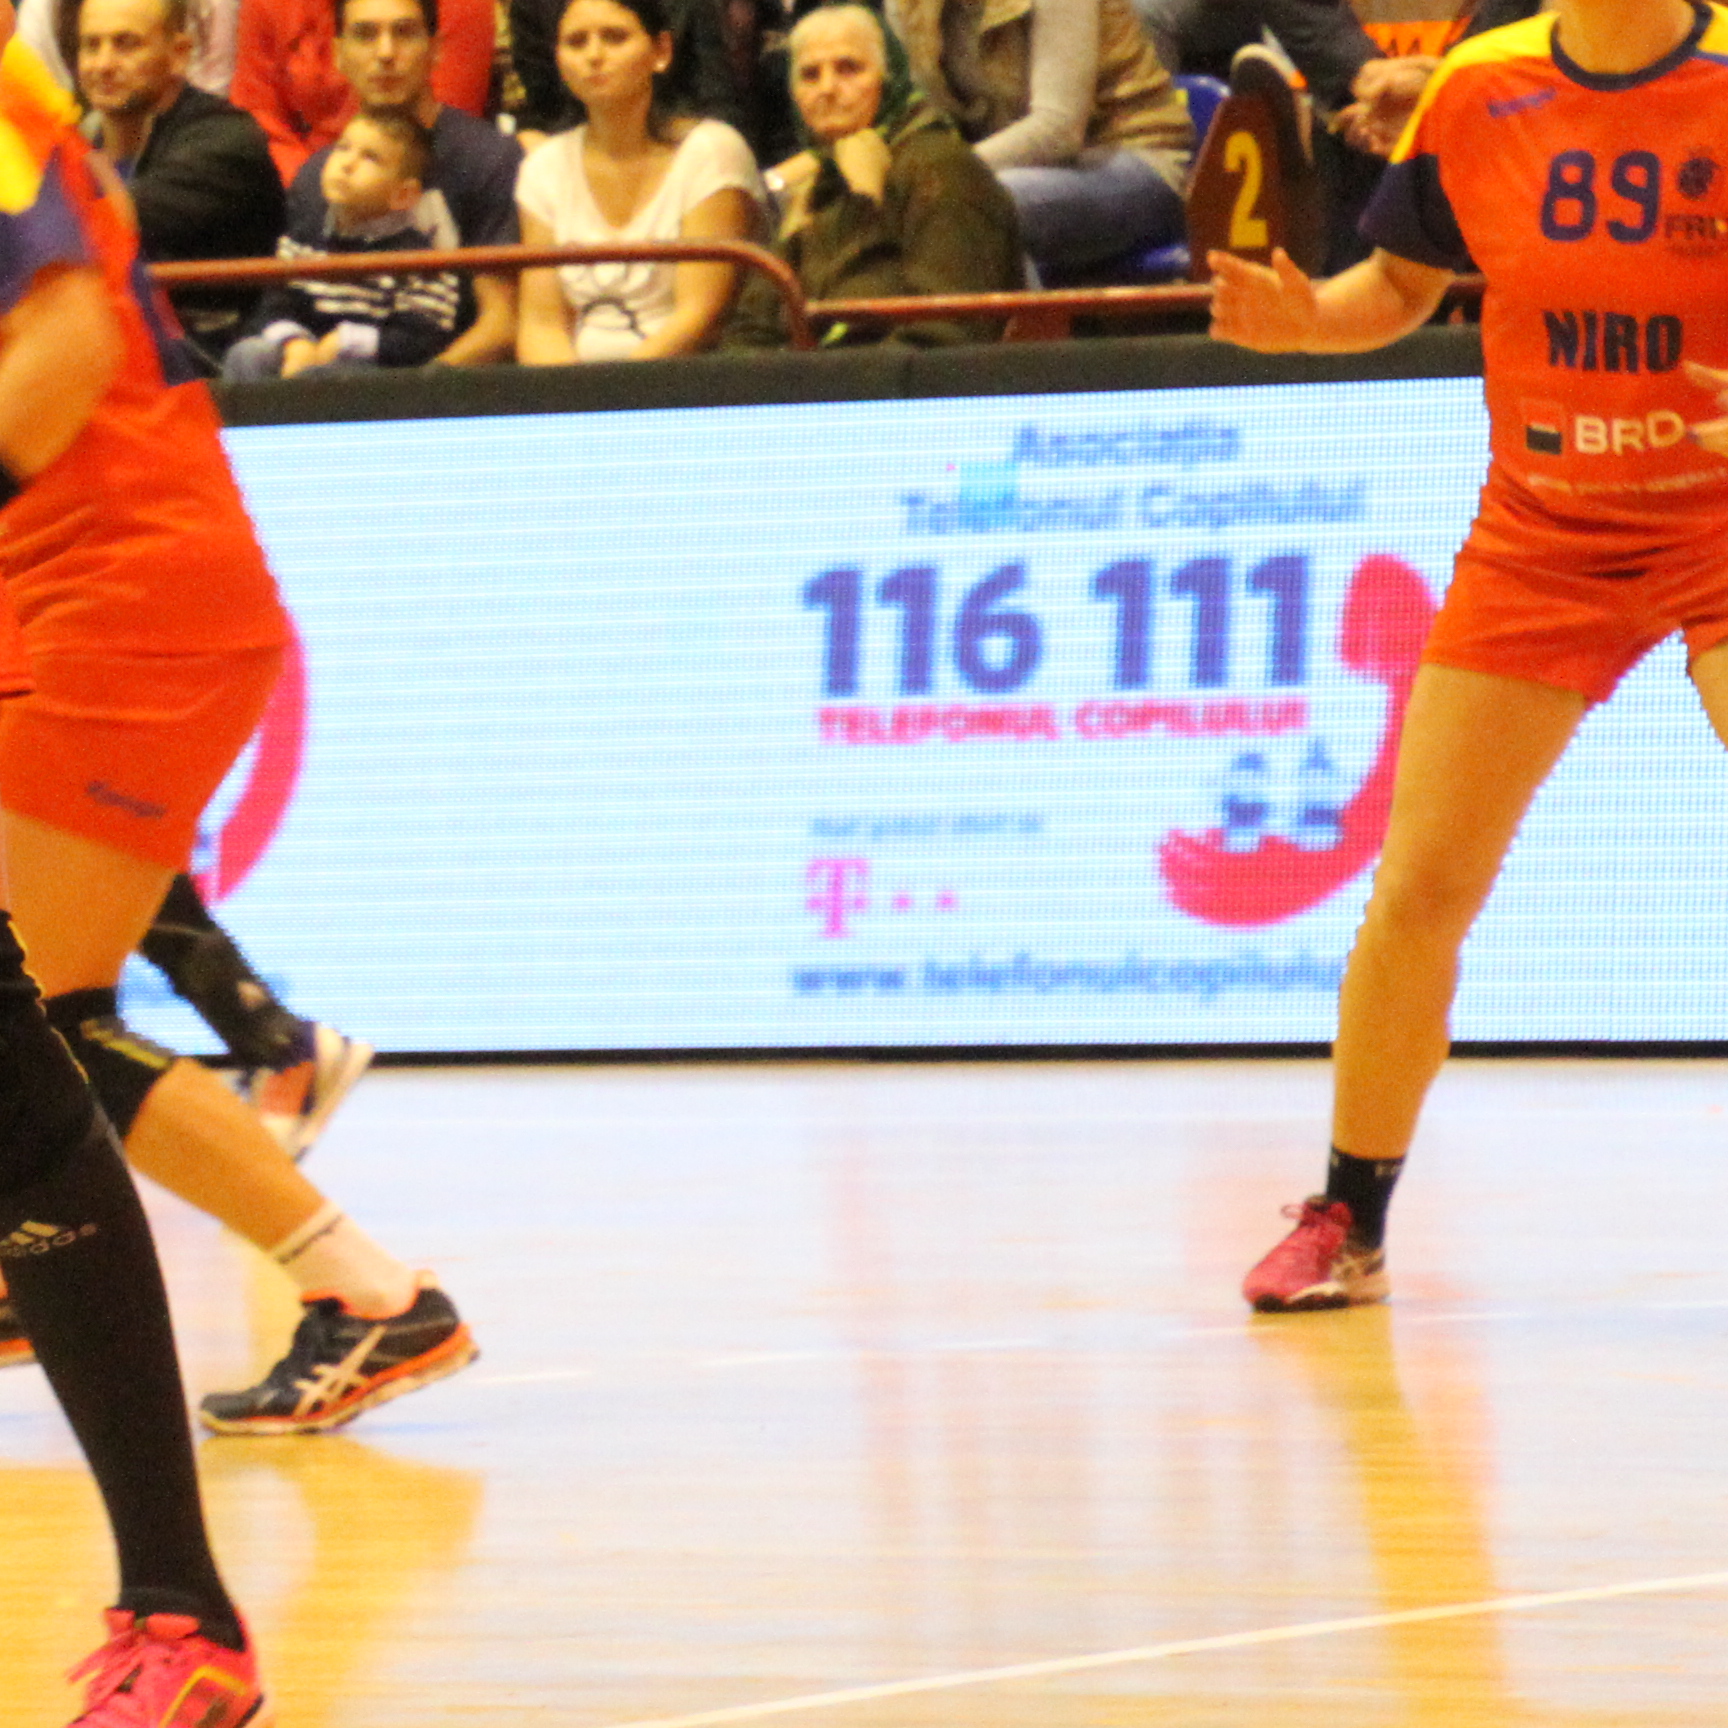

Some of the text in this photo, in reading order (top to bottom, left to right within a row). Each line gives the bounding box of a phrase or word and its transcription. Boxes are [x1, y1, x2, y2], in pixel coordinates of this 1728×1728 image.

[1224, 131, 1268, 248] 2
[1539, 149, 1662, 245] 89
[1543, 309, 1684, 373] NIRO
[1574, 410, 1685, 456] BRD
[805, 554, 1311, 697] 116 111
[1075, 695, 1310, 738] COPILULUI
